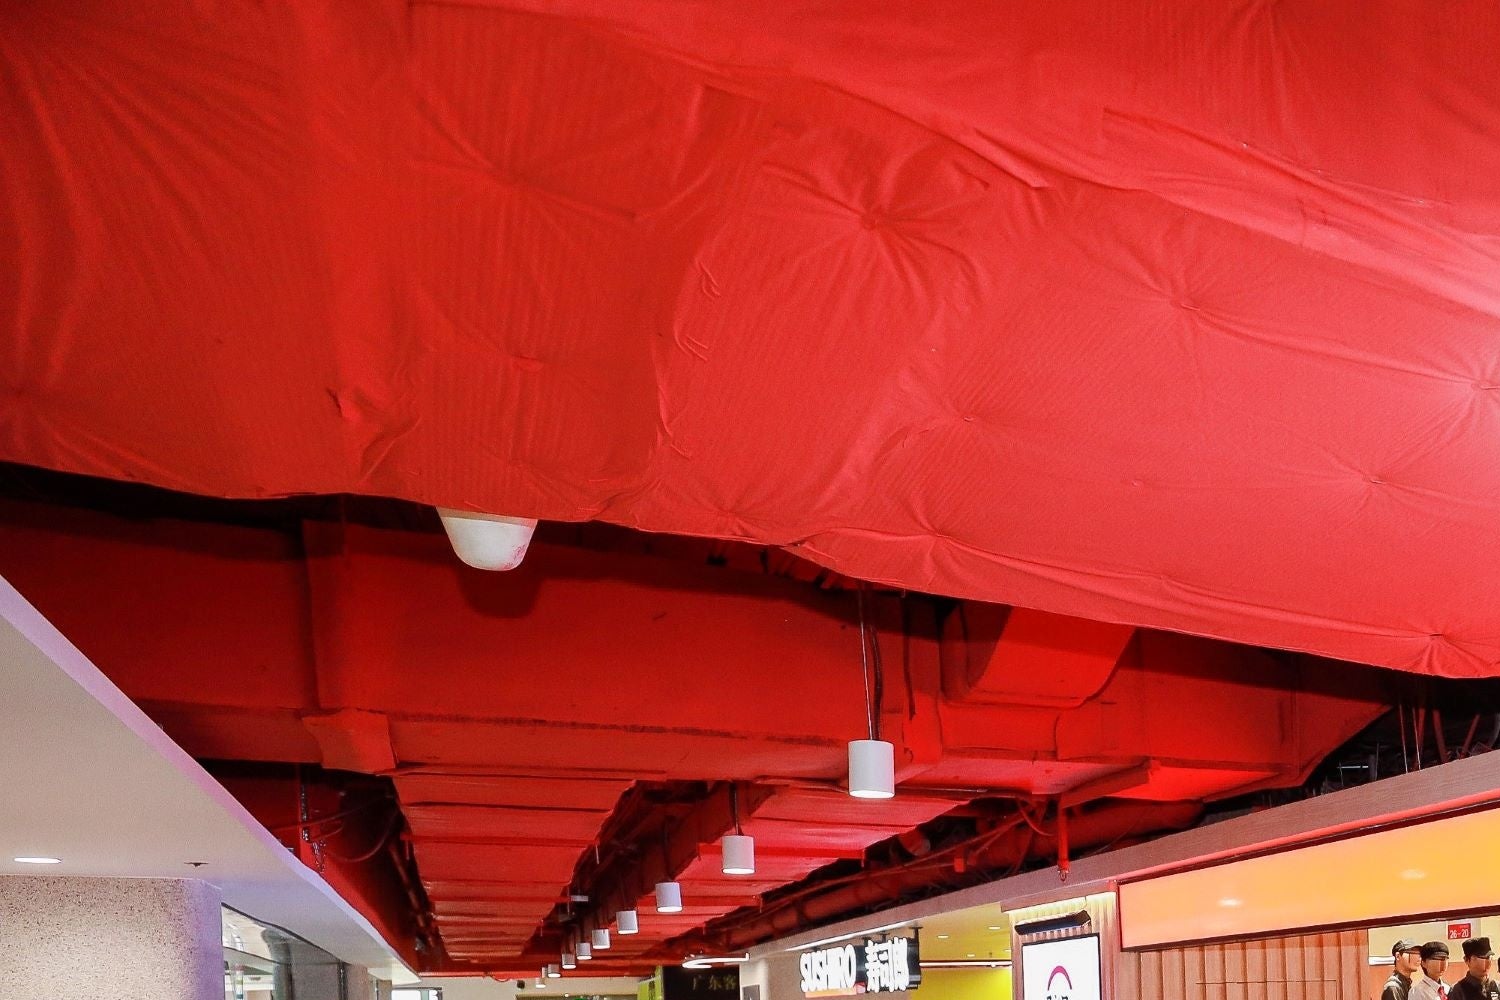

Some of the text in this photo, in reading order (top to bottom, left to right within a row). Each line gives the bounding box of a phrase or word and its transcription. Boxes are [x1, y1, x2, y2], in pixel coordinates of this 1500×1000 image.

[1450, 928, 1469, 939] 26-20
[800, 944, 857, 993] SUSHIRO
[865, 936, 910, 993] 寿司郎
